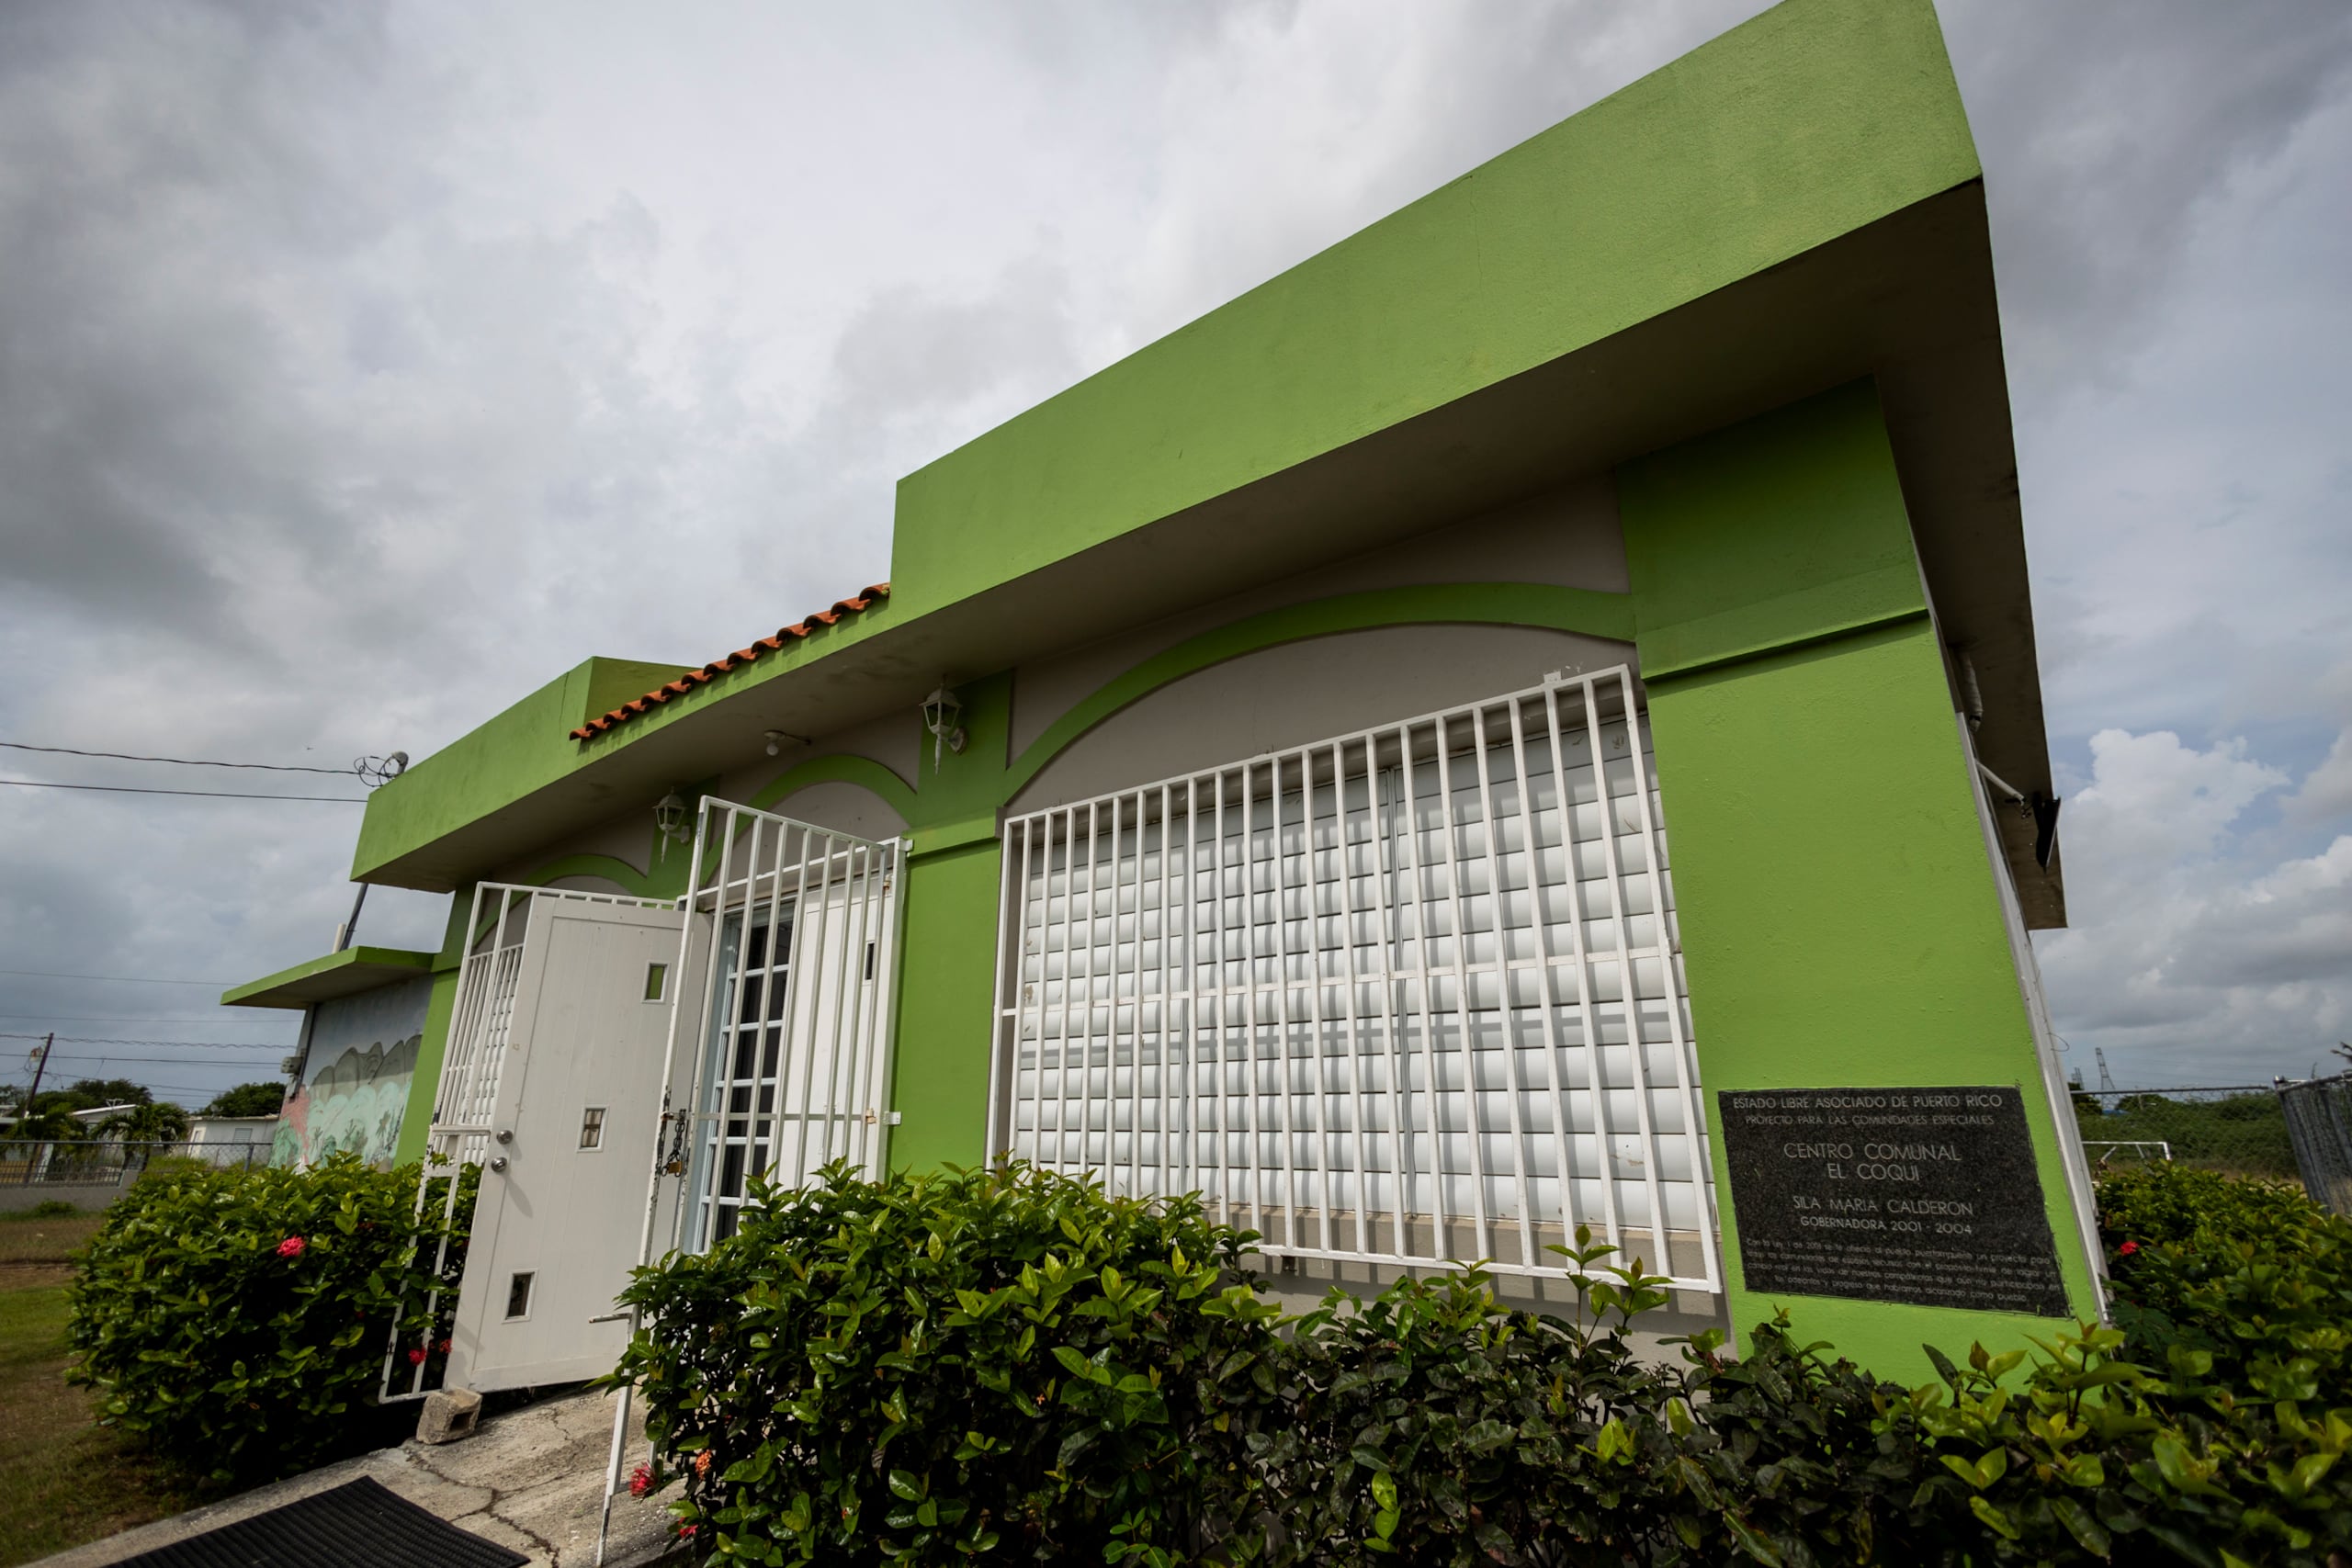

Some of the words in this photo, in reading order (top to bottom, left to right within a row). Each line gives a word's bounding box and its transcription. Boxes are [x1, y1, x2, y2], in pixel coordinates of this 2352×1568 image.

[1733, 1097, 1776, 1109] ESTADO
[1781, 1097, 1810, 1109] LIBRE
[1815, 1096, 1886, 1109] ASOCIADO
[1891, 1095, 1908, 1108] DE
[1913, 1094, 1961, 1108] PUERTO
[1965, 1094, 2003, 1108] RICO
[1746, 1114, 1793, 1125] PROYECTO
[1797, 1115, 1824, 1125] PARA
[1828, 1115, 1848, 1125] LAS
[1932, 1114, 1995, 1125] ESPECIALES
[1783, 1142, 1854, 1160] CENTRO
[1863, 1142, 1962, 1162] COMUNAL
[1826, 1162, 1846, 1179] EL
[1856, 1162, 1920, 1182] COQUI
[1792, 1195, 1821, 1210] SILA
[1829, 1198, 1879, 1212] MARIA
[1886, 1198, 1974, 1217] CALDERON
[1800, 1215, 1887, 1231] GOBERNADORA
[1891, 1220, 1922, 1233] 2001
[1935, 1222, 1972, 1235] 2004
